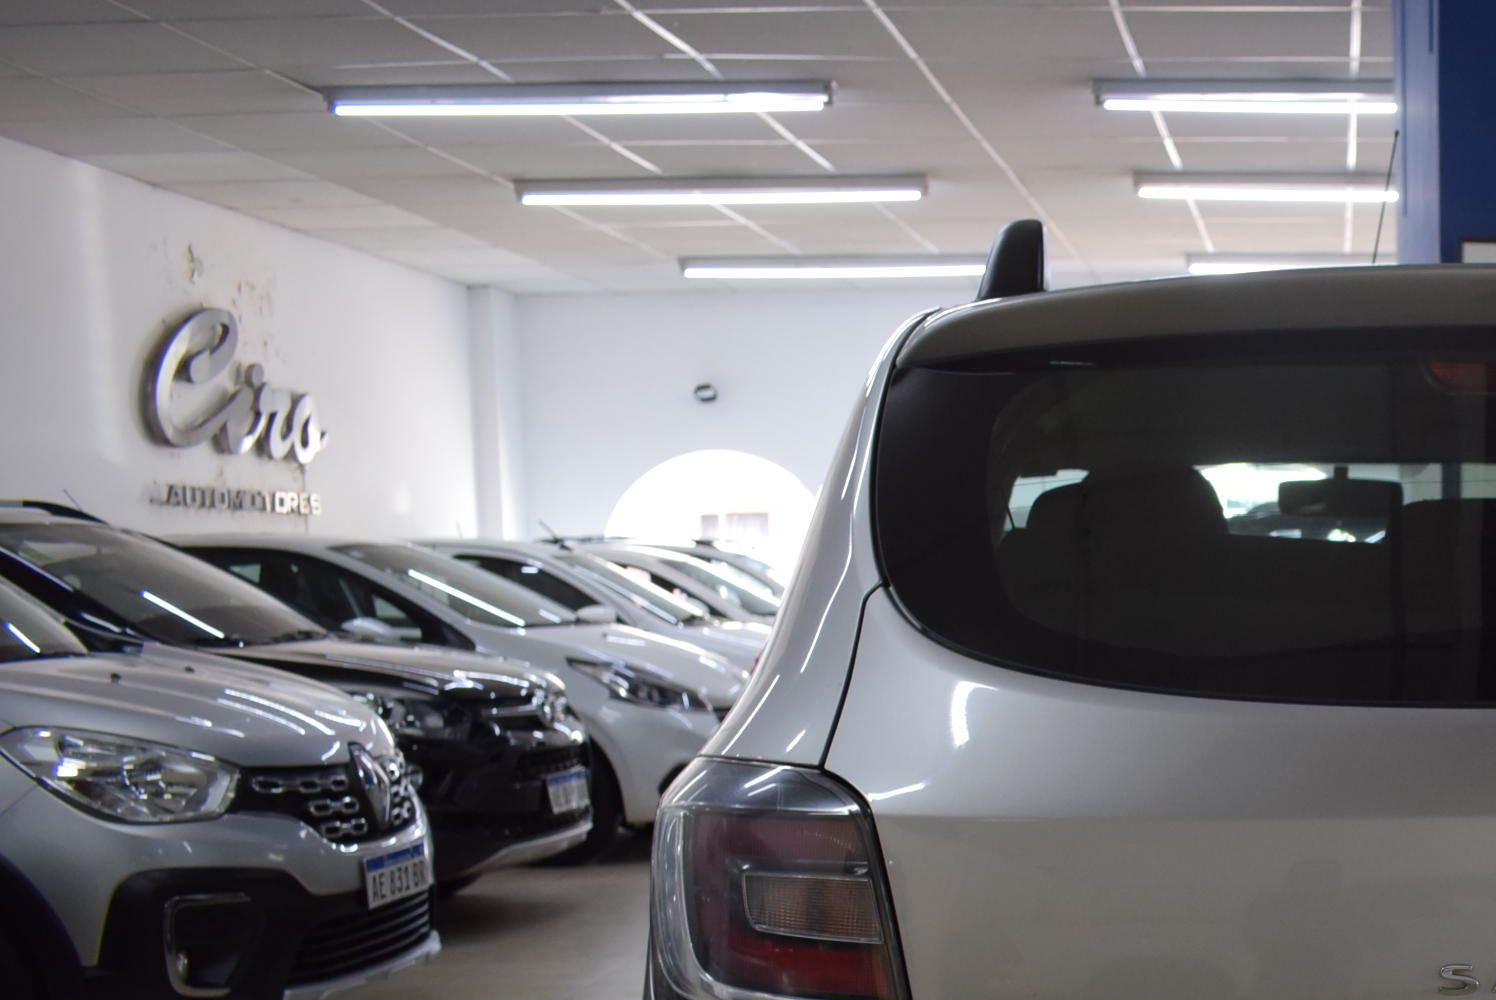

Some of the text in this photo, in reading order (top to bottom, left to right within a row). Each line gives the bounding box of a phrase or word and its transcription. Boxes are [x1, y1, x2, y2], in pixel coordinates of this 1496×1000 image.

[145, 307, 329, 466] Ciro
[164, 483, 322, 516] AUTOMOTORES
[372, 872, 387, 901] AE
[389, 866, 410, 895] 831
